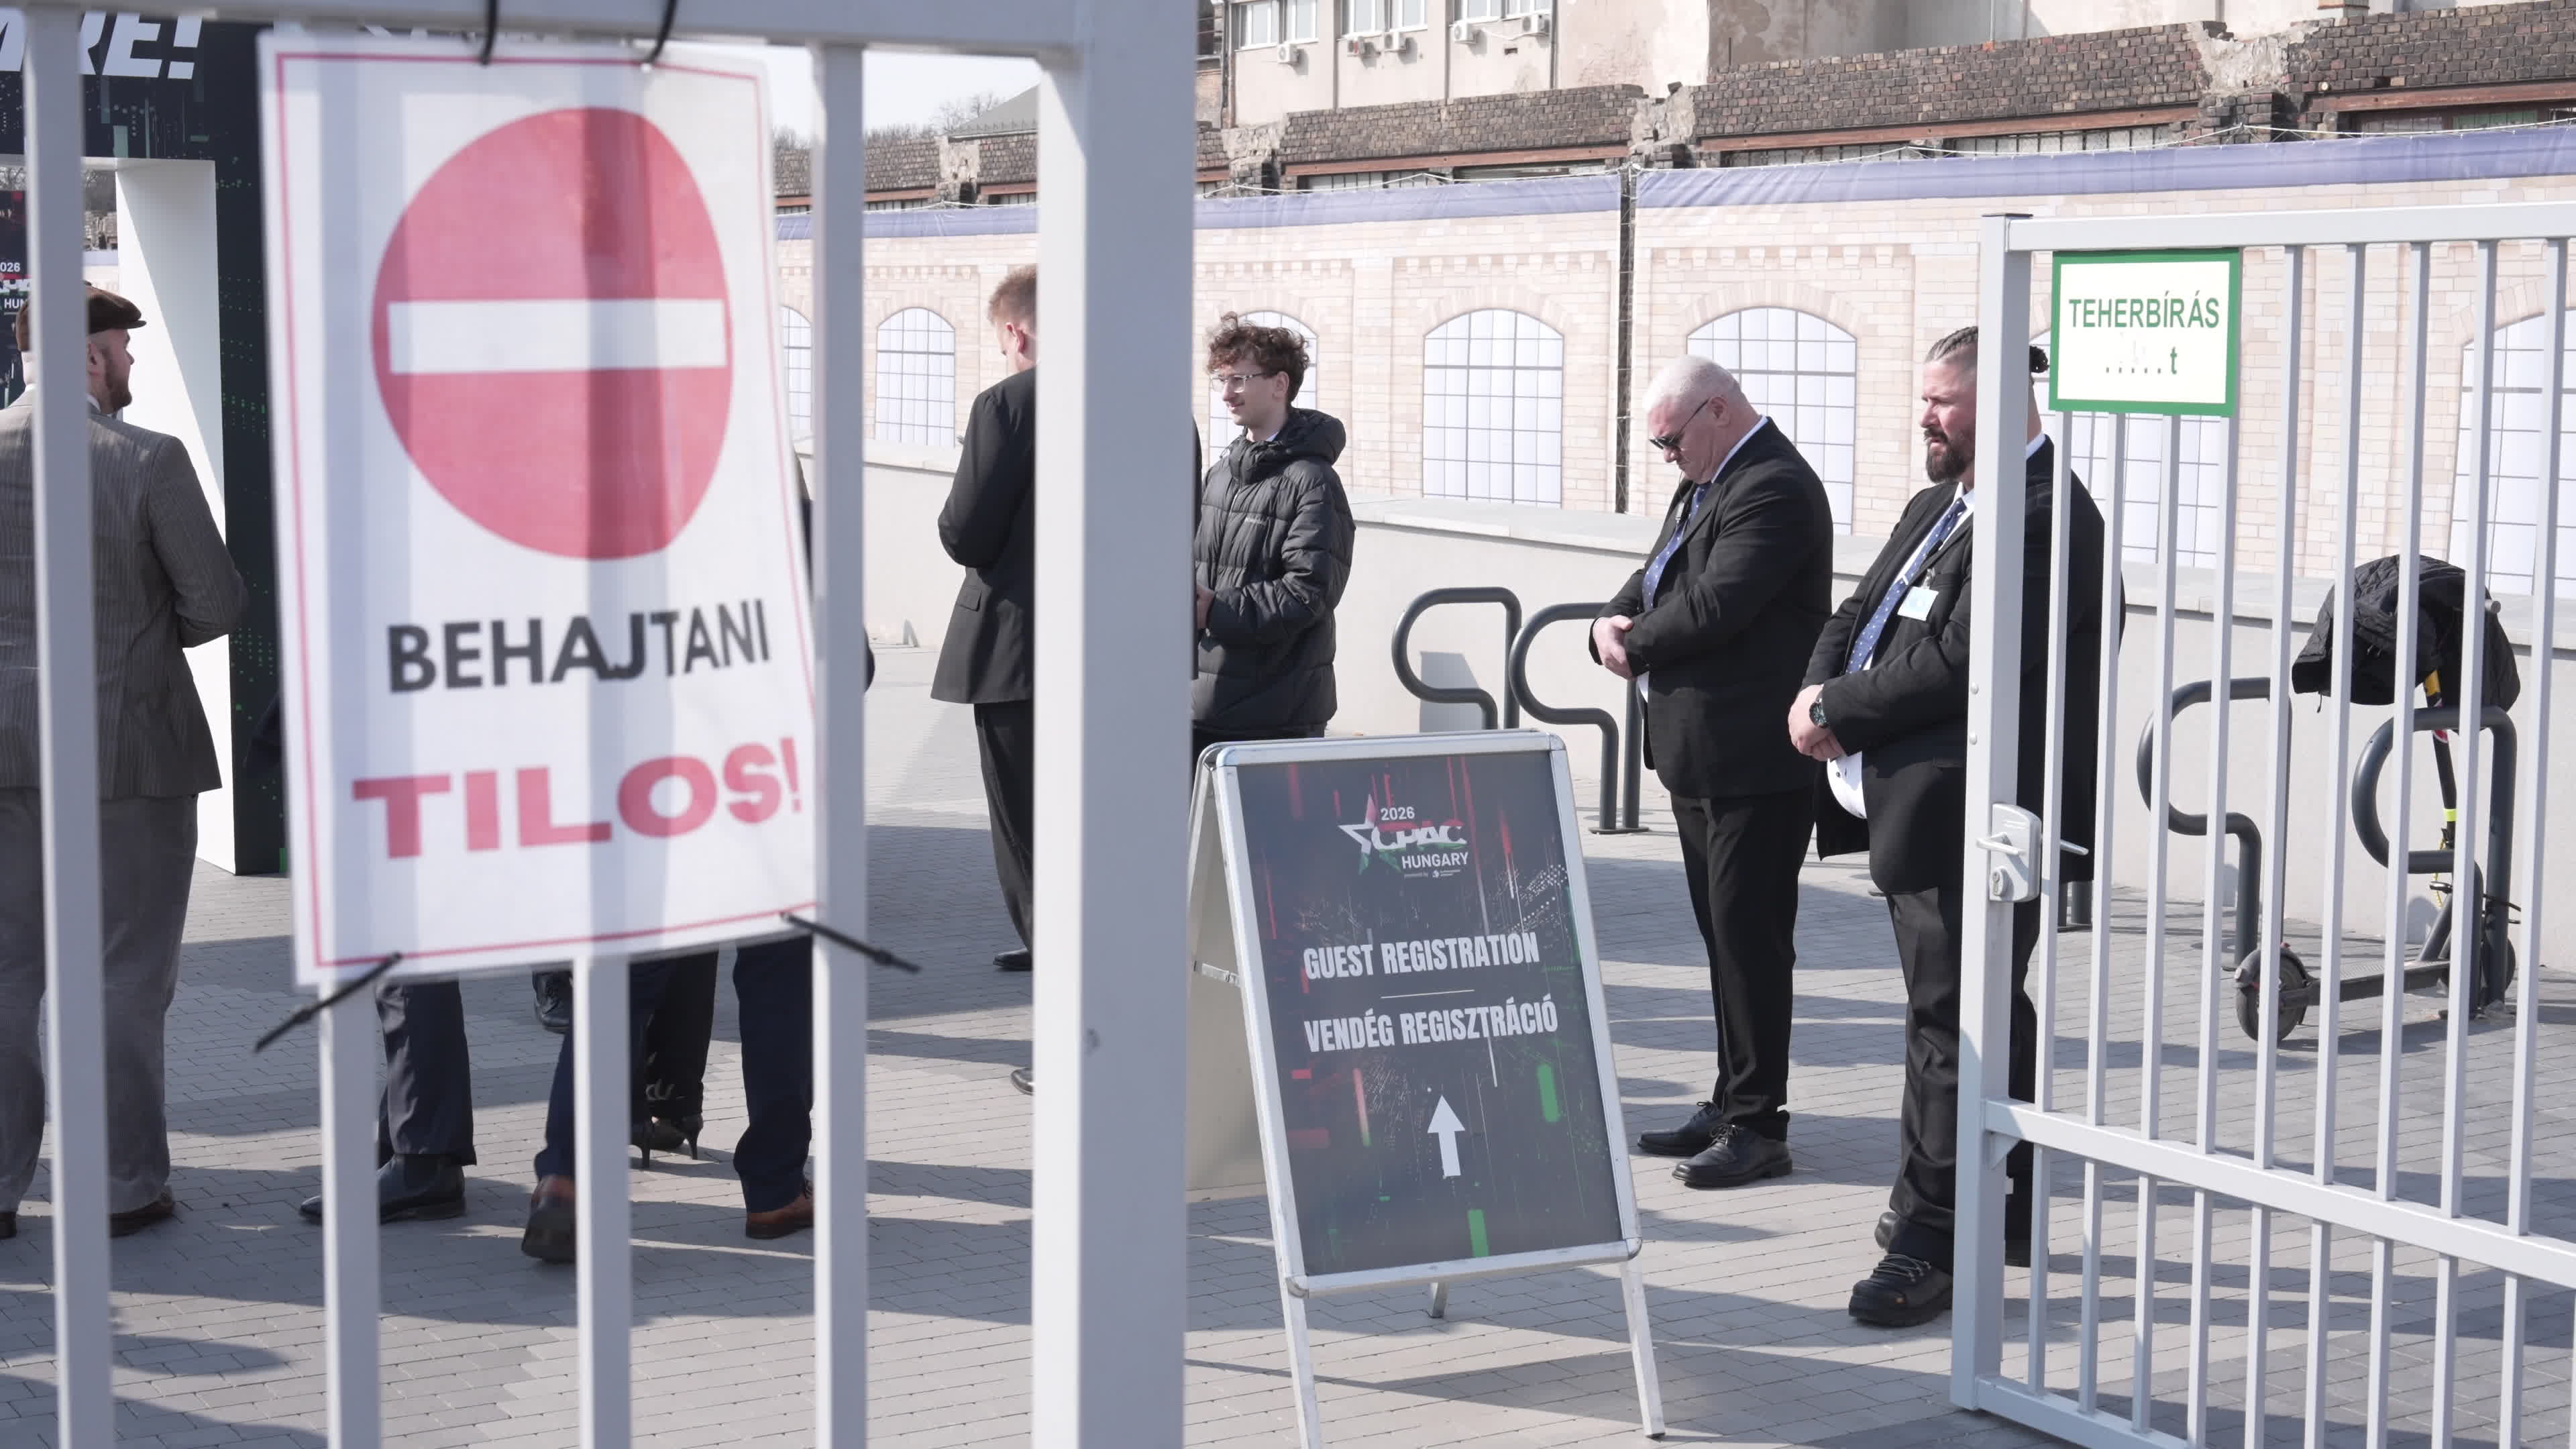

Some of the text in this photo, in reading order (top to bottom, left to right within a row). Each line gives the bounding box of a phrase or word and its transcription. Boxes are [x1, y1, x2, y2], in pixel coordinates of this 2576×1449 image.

[0, 262, 20, 272] 026
[2069, 290, 2220, 328] TEHERBÍRÁS
[387, 598, 771, 693] BEHAJTANI
[352, 737, 802, 859] TILOS!
[1381, 806, 1415, 820] 2026
[1371, 819, 1467, 850] CPAC
[1401, 852, 1468, 869] HUNGARY
[1303, 932, 1540, 979] GUEST REGISTRATION
[1304, 994, 1558, 1053] VENDÉG REGISZTRÁCIÓ
